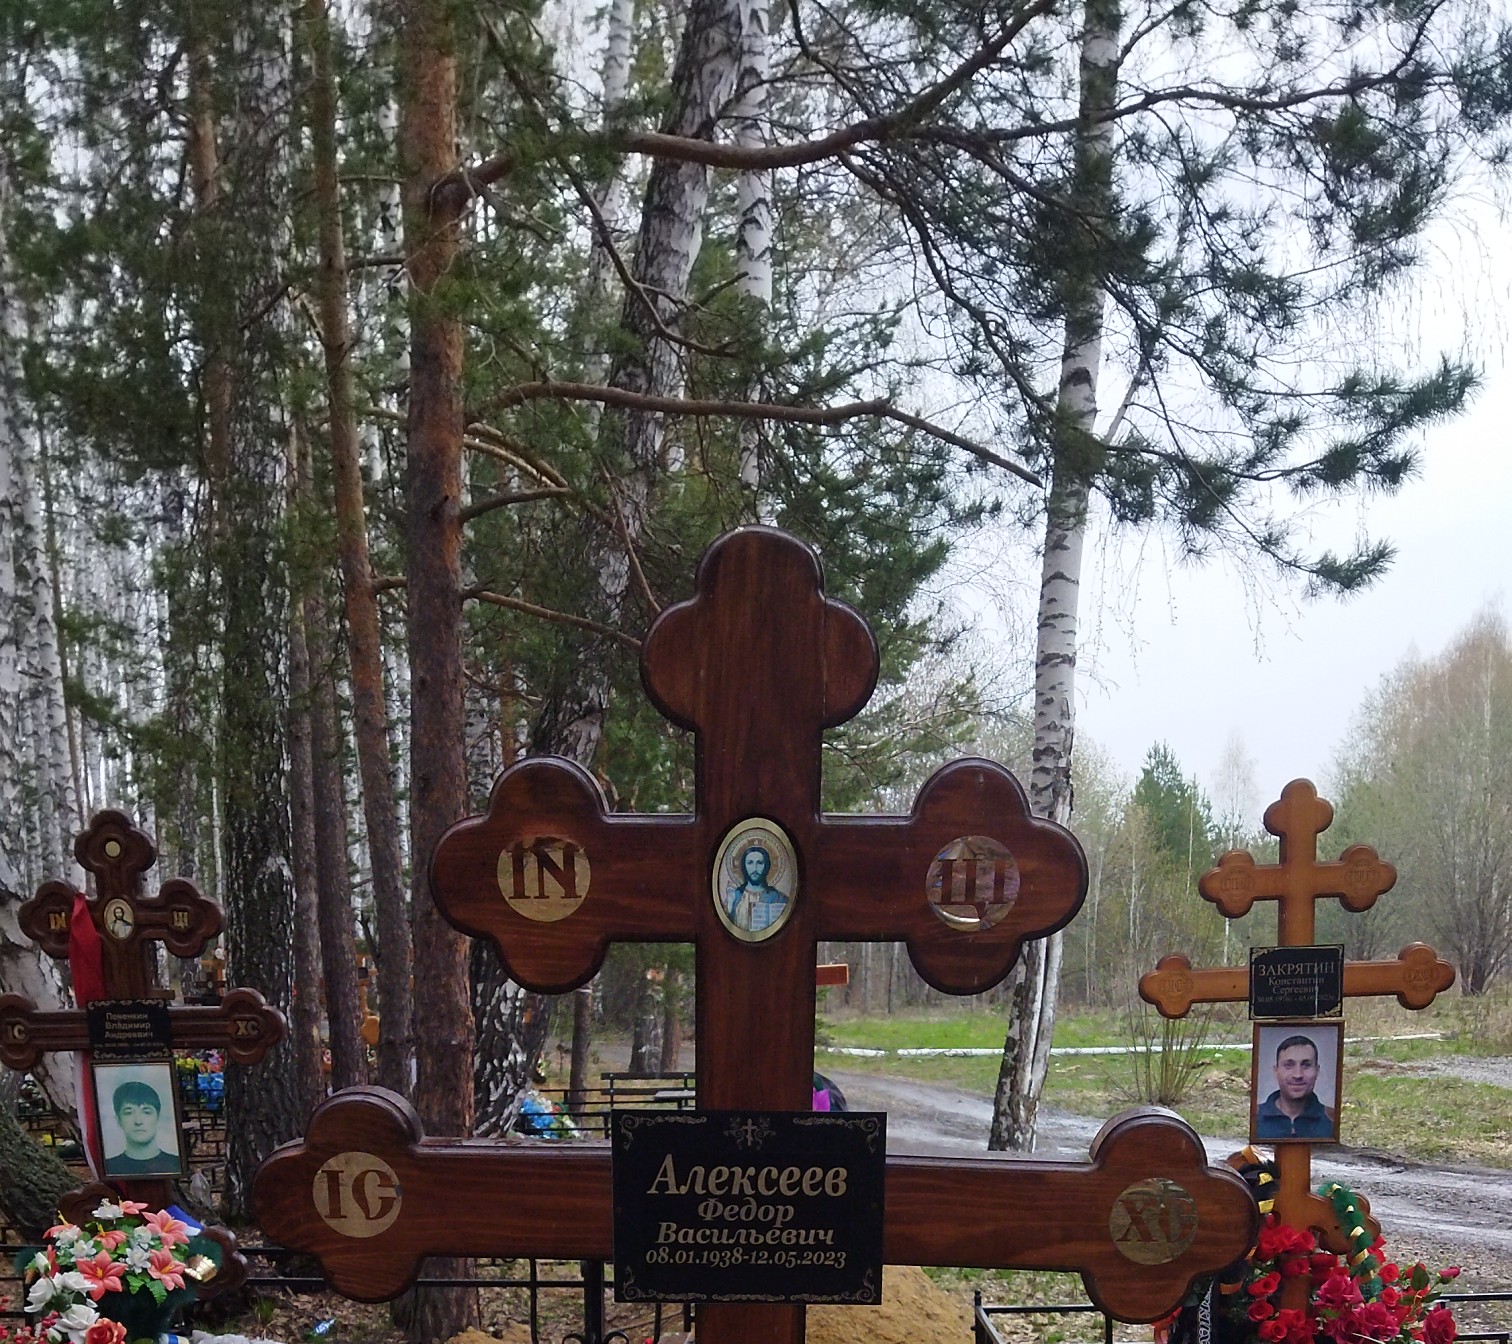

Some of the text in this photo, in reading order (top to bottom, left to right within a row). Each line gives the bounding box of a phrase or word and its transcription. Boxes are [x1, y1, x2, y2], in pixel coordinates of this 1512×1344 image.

[1258, 961, 1335, 977] ЗАКРЯТИН
[1268, 976, 1325, 986] Константин
[104, 1031, 154, 1039] Андреевич
[105, 1021, 151, 1031] Владимир
[646, 1153, 848, 1197] Алексеев
[697, 1197, 795, 1228] Федор
[655, 1222, 834, 1245] Васильевич
[645, 1246, 847, 1269] 08.01.1938-12.05.2023
